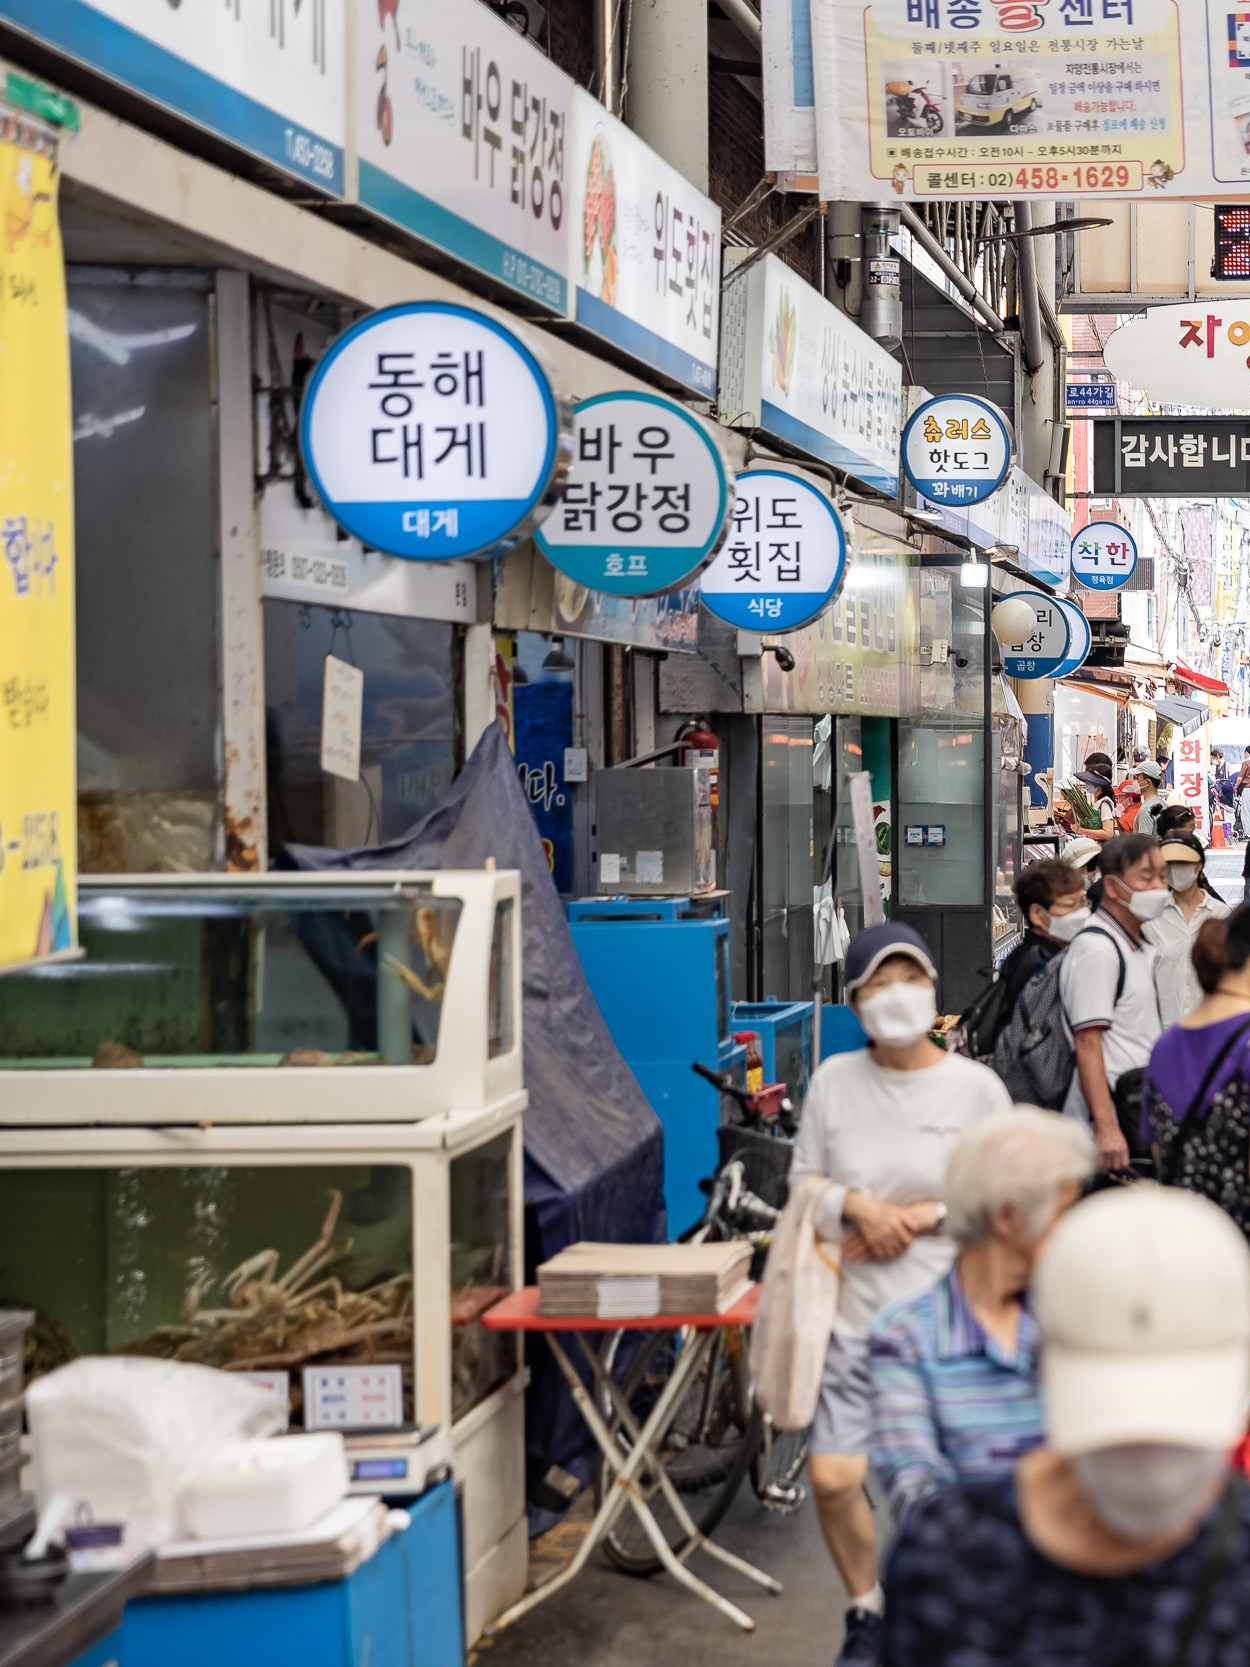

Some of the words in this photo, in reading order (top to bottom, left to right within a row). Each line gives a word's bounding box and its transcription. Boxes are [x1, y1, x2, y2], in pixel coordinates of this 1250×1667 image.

[906, 0, 982, 30] 배송
[1058, 0, 1136, 26] 센터
[911, 40, 982, 55] 둘째/넷째주
[989, 40, 1041, 53] 일요일은
[1047, 39, 1098, 53] 전통시장
[1105, 37, 1145, 51] 가는날
[1065, 61, 1142, 75] 자양전통시장에서는
[1134, 80, 1160, 93] 하시면
[461, 45, 503, 189] 바우
[897, 127, 934, 138] 오토바이
[510, 79, 566, 232] 닭강정
[900, 147, 968, 158] 배송접수시간
[978, 146, 1025, 158] 오전10시
[1036, 144, 1122, 157] 오후5시30분까지
[926, 172, 976, 189] 콜센터
[368, 350, 485, 418] 동해
[1066, 386, 1114, 399] 로44가길
[923, 415, 992, 443] 츄러스
[370, 421, 487, 480] 대게
[579, 424, 676, 475] 바우
[928, 449, 990, 473] 핫도그
[931, 481, 978, 499] 꽈배기
[561, 481, 691, 534] 닭강정
[732, 496, 803, 533] 위도
[402, 507, 459, 538] 대게
[603, 553, 648, 576] 호프
[727, 541, 801, 582] 횟집
[1077, 541, 1130, 566] 착한
[1091, 575, 1114, 585] 정육점
[747, 597, 783, 618] 식당
[1037, 608, 1053, 628] 리
[1010, 632, 1045, 653] 창
[1016, 660, 1037, 672] 곱창
[515, 761, 566, 812] 다.
